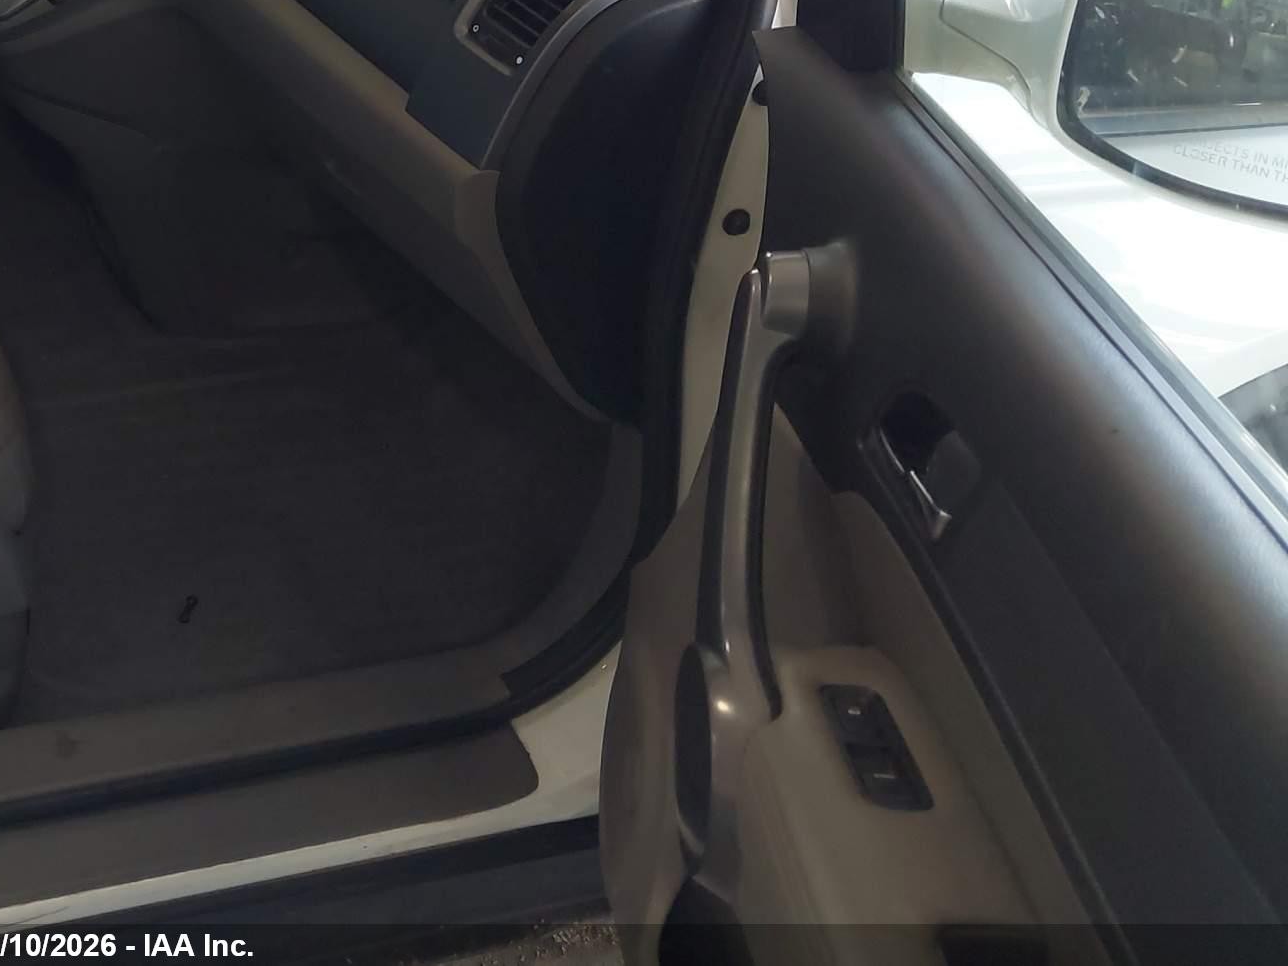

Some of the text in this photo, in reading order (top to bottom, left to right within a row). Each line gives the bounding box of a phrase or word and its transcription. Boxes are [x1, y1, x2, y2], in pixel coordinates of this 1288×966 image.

[1174, 143, 1228, 169] CLOSER
[1231, 158, 1270, 180] THAN
[1252, 150, 1270, 166] IN
